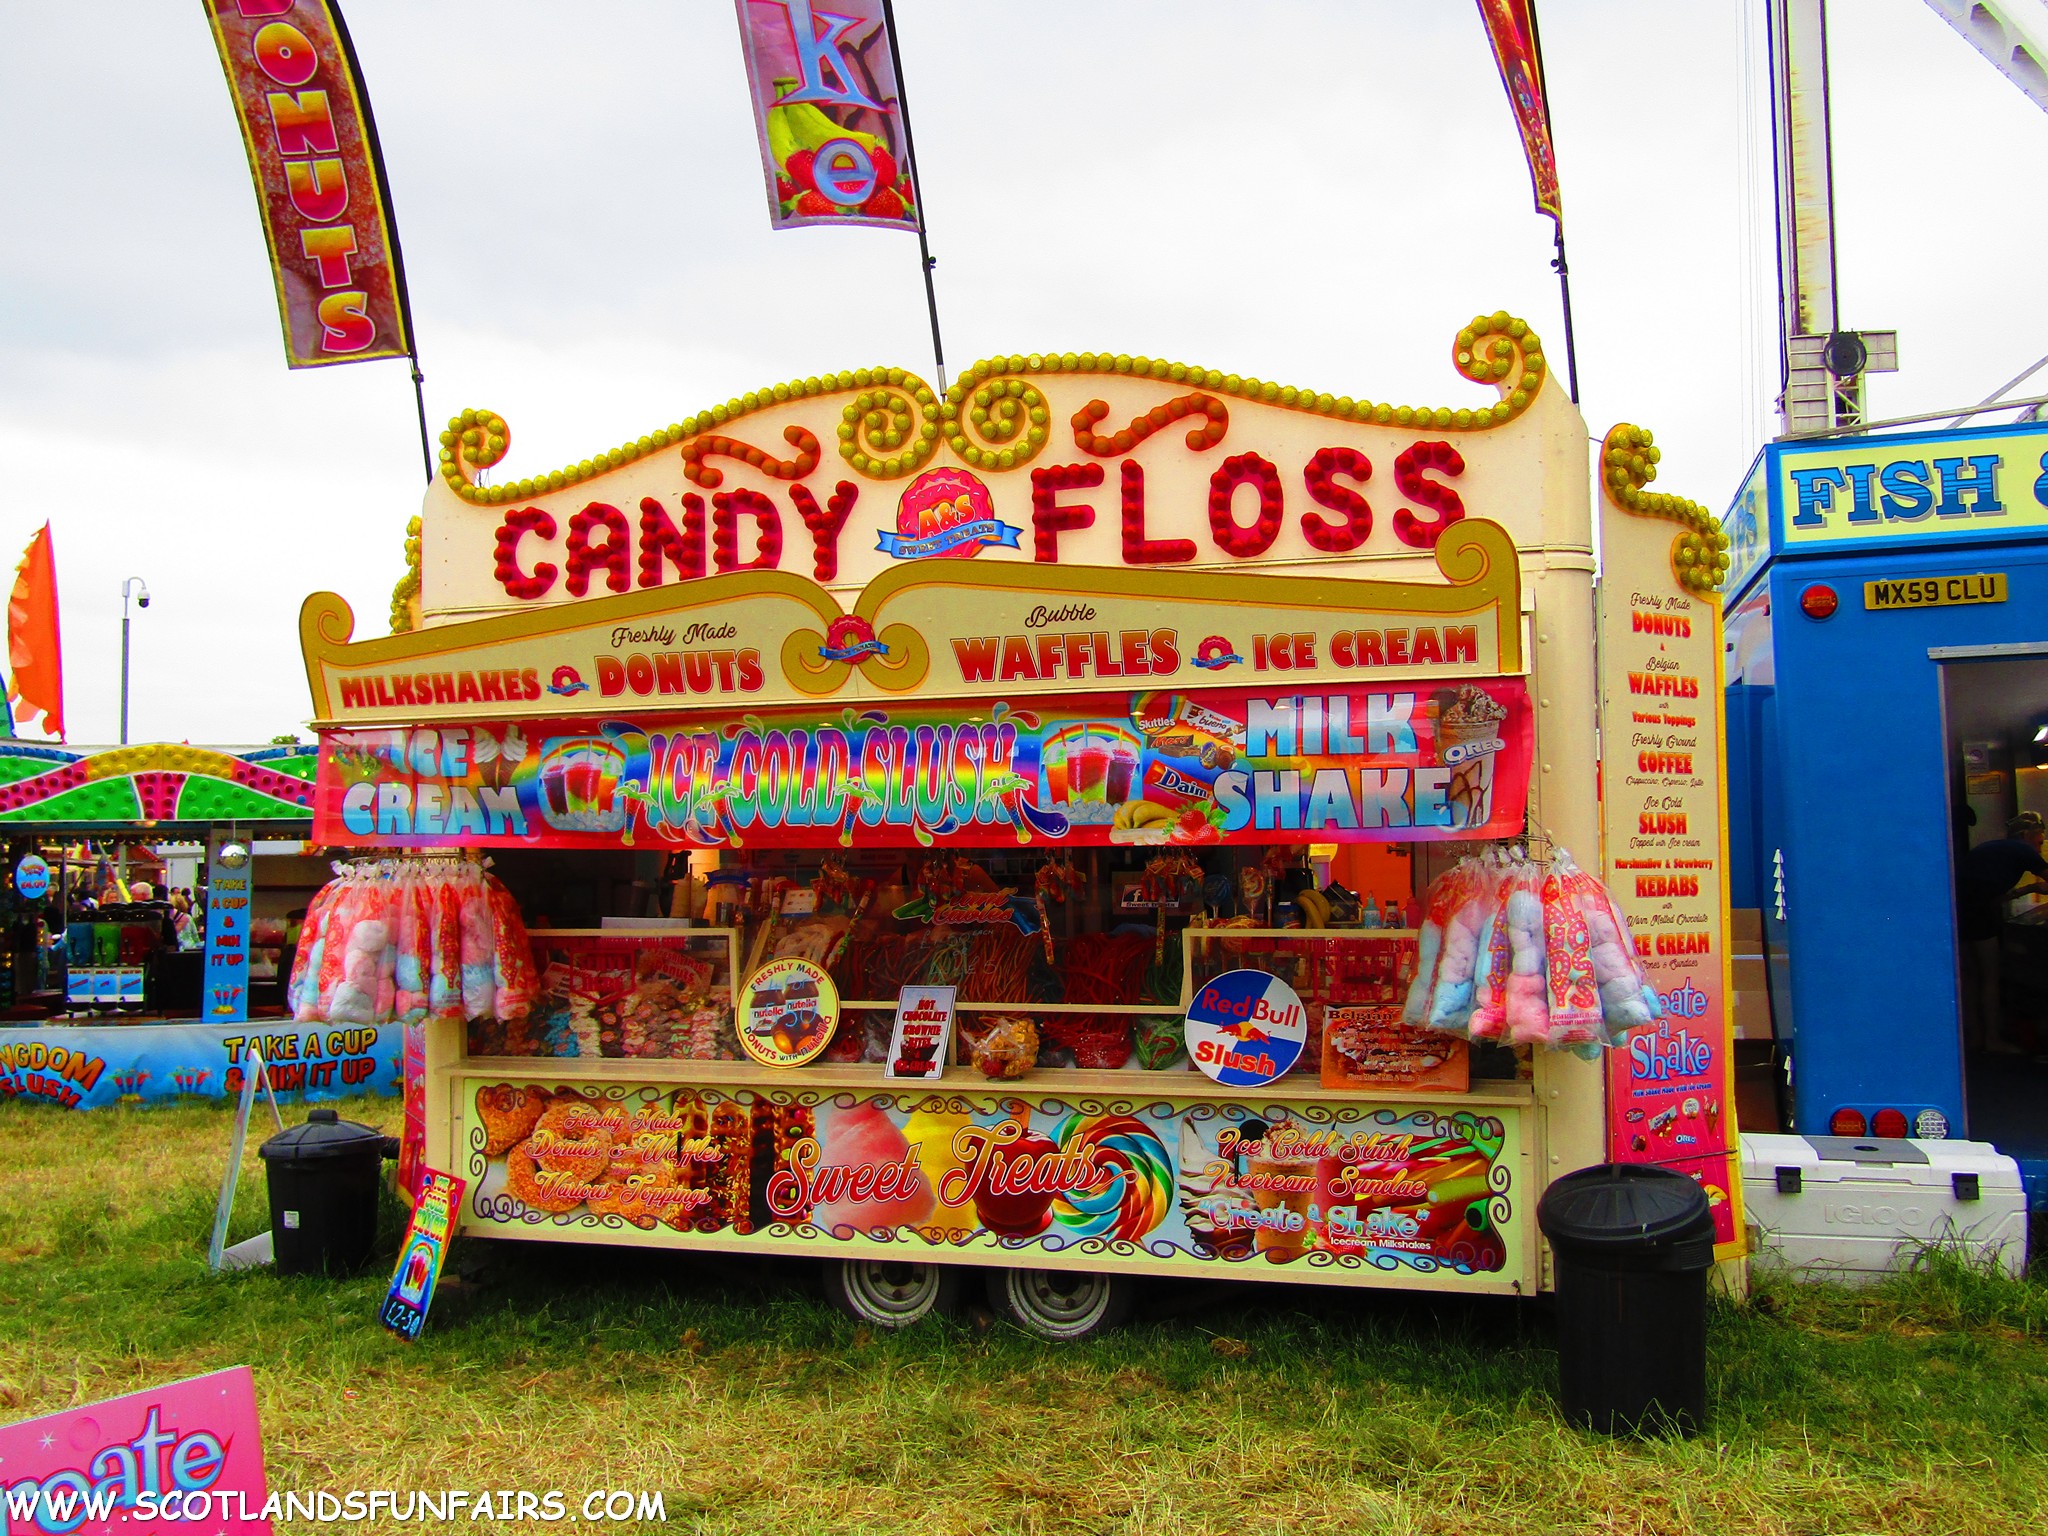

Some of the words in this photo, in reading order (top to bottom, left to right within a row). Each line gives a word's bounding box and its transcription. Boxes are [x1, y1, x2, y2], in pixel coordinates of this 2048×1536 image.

[1032, 440, 1465, 563] FLOSS
[1790, 454, 2003, 526] FISH
[918, 494, 976, 540] A&S
[494, 480, 859, 599] CANDY
[898, 539, 942, 555] SWEET
[945, 522, 995, 545] TREATS
[1630, 592, 1662, 609] Freshly
[1665, 597, 1691, 611] Made
[1874, 581, 1939, 605] MX59
[1947, 577, 1995, 600] CLU
[1024, 603, 1097, 629] Bubble
[1632, 610, 1691, 639] DONUTS
[611, 626, 676, 648] Freshly
[683, 622, 738, 642] Made
[1252, 632, 1318, 672] ICE
[1329, 624, 1479, 668] CREAM
[950, 627, 1181, 683] WAFFLES
[1646, 656, 1680, 672] Belgian
[594, 647, 766, 698] DONUTS
[1627, 671, 1699, 699] WAFFLES
[337, 667, 543, 709] MILKSHAKES
[1138, 717, 1176, 731] Skittles
[1198, 715, 1227, 729] bueno
[1245, 691, 1419, 758] MILK
[1443, 738, 1506, 765] OREO
[1632, 733, 1663, 748] Freshly
[1666, 735, 1697, 748] Ground
[645, 730, 720, 829] ICE
[726, 727, 850, 828] COLD
[858, 720, 1020, 828] SLUSH
[1638, 750, 1693, 775] COFFEE
[1157, 766, 1208, 800] Daim
[341, 781, 529, 836] CREAM
[1212, 767, 1452, 832] SHAKE
[1644, 796, 1659, 810] Ice
[1662, 796, 1682, 810] Cold
[1639, 811, 1688, 835] SLUSH
[214, 879, 247, 890] TAKE
[1635, 874, 1699, 898] KEBABS
[211, 897, 220, 909] A
[222, 897, 248, 909] CUP
[223, 916, 234, 928] &
[1633, 934, 1651, 956] CE
[1656, 931, 1710, 955] CREAM
[211, 954, 224, 966] IT
[226, 953, 244, 966] UP
[750, 962, 793, 991] FRESHLY
[796, 964, 825, 984] MADE
[753, 1006, 784, 1018] nutella
[787, 999, 817, 1010] nutella
[918, 1000, 936, 1010] HOT
[1202, 988, 1251, 1017] Red
[1252, 998, 1300, 1028] Bull
[1659, 977, 1709, 1019] eate
[902, 1011, 947, 1022] CHOCOLATE
[903, 1025, 942, 1035] BROWNIE
[1328, 1010, 1393, 1021] Belgian
[1658, 1018, 1671, 1040] a
[223, 1034, 299, 1064] TAKE
[303, 1032, 322, 1058] A
[327, 1028, 378, 1056] CUP
[743, 1026, 777, 1060] DONUTS
[800, 1015, 832, 1056] nutella
[0, 1042, 107, 1093] NGDOM
[1195, 1040, 1276, 1077] Slush
[1630, 1029, 1713, 1081] Shake
[309, 1060, 337, 1087] IT
[341, 1057, 376, 1084] UP
[563, 1106, 624, 1132] Freshly
[629, 1107, 683, 1131] Made
[524, 1129, 600, 1160] Donuts
[638, 1131, 724, 1168] Waffles
[1215, 1128, 1263, 1158] Ice
[1271, 1128, 1330, 1161] Cold
[1338, 1129, 1413, 1163] Slush
[766, 1137, 922, 1217] Sweet
[938, 1118, 1112, 1208] Treats
[1203, 1161, 1319, 1192] Icecream
[1327, 1166, 1428, 1198] Sundae
[534, 1170, 612, 1201] Various
[619, 1172, 713, 1211] Toppings
[1330, 1236, 1376, 1247] Icecream
[1379, 1239, 1431, 1250] Milkshakes
[0, 1403, 234, 1536] reate
